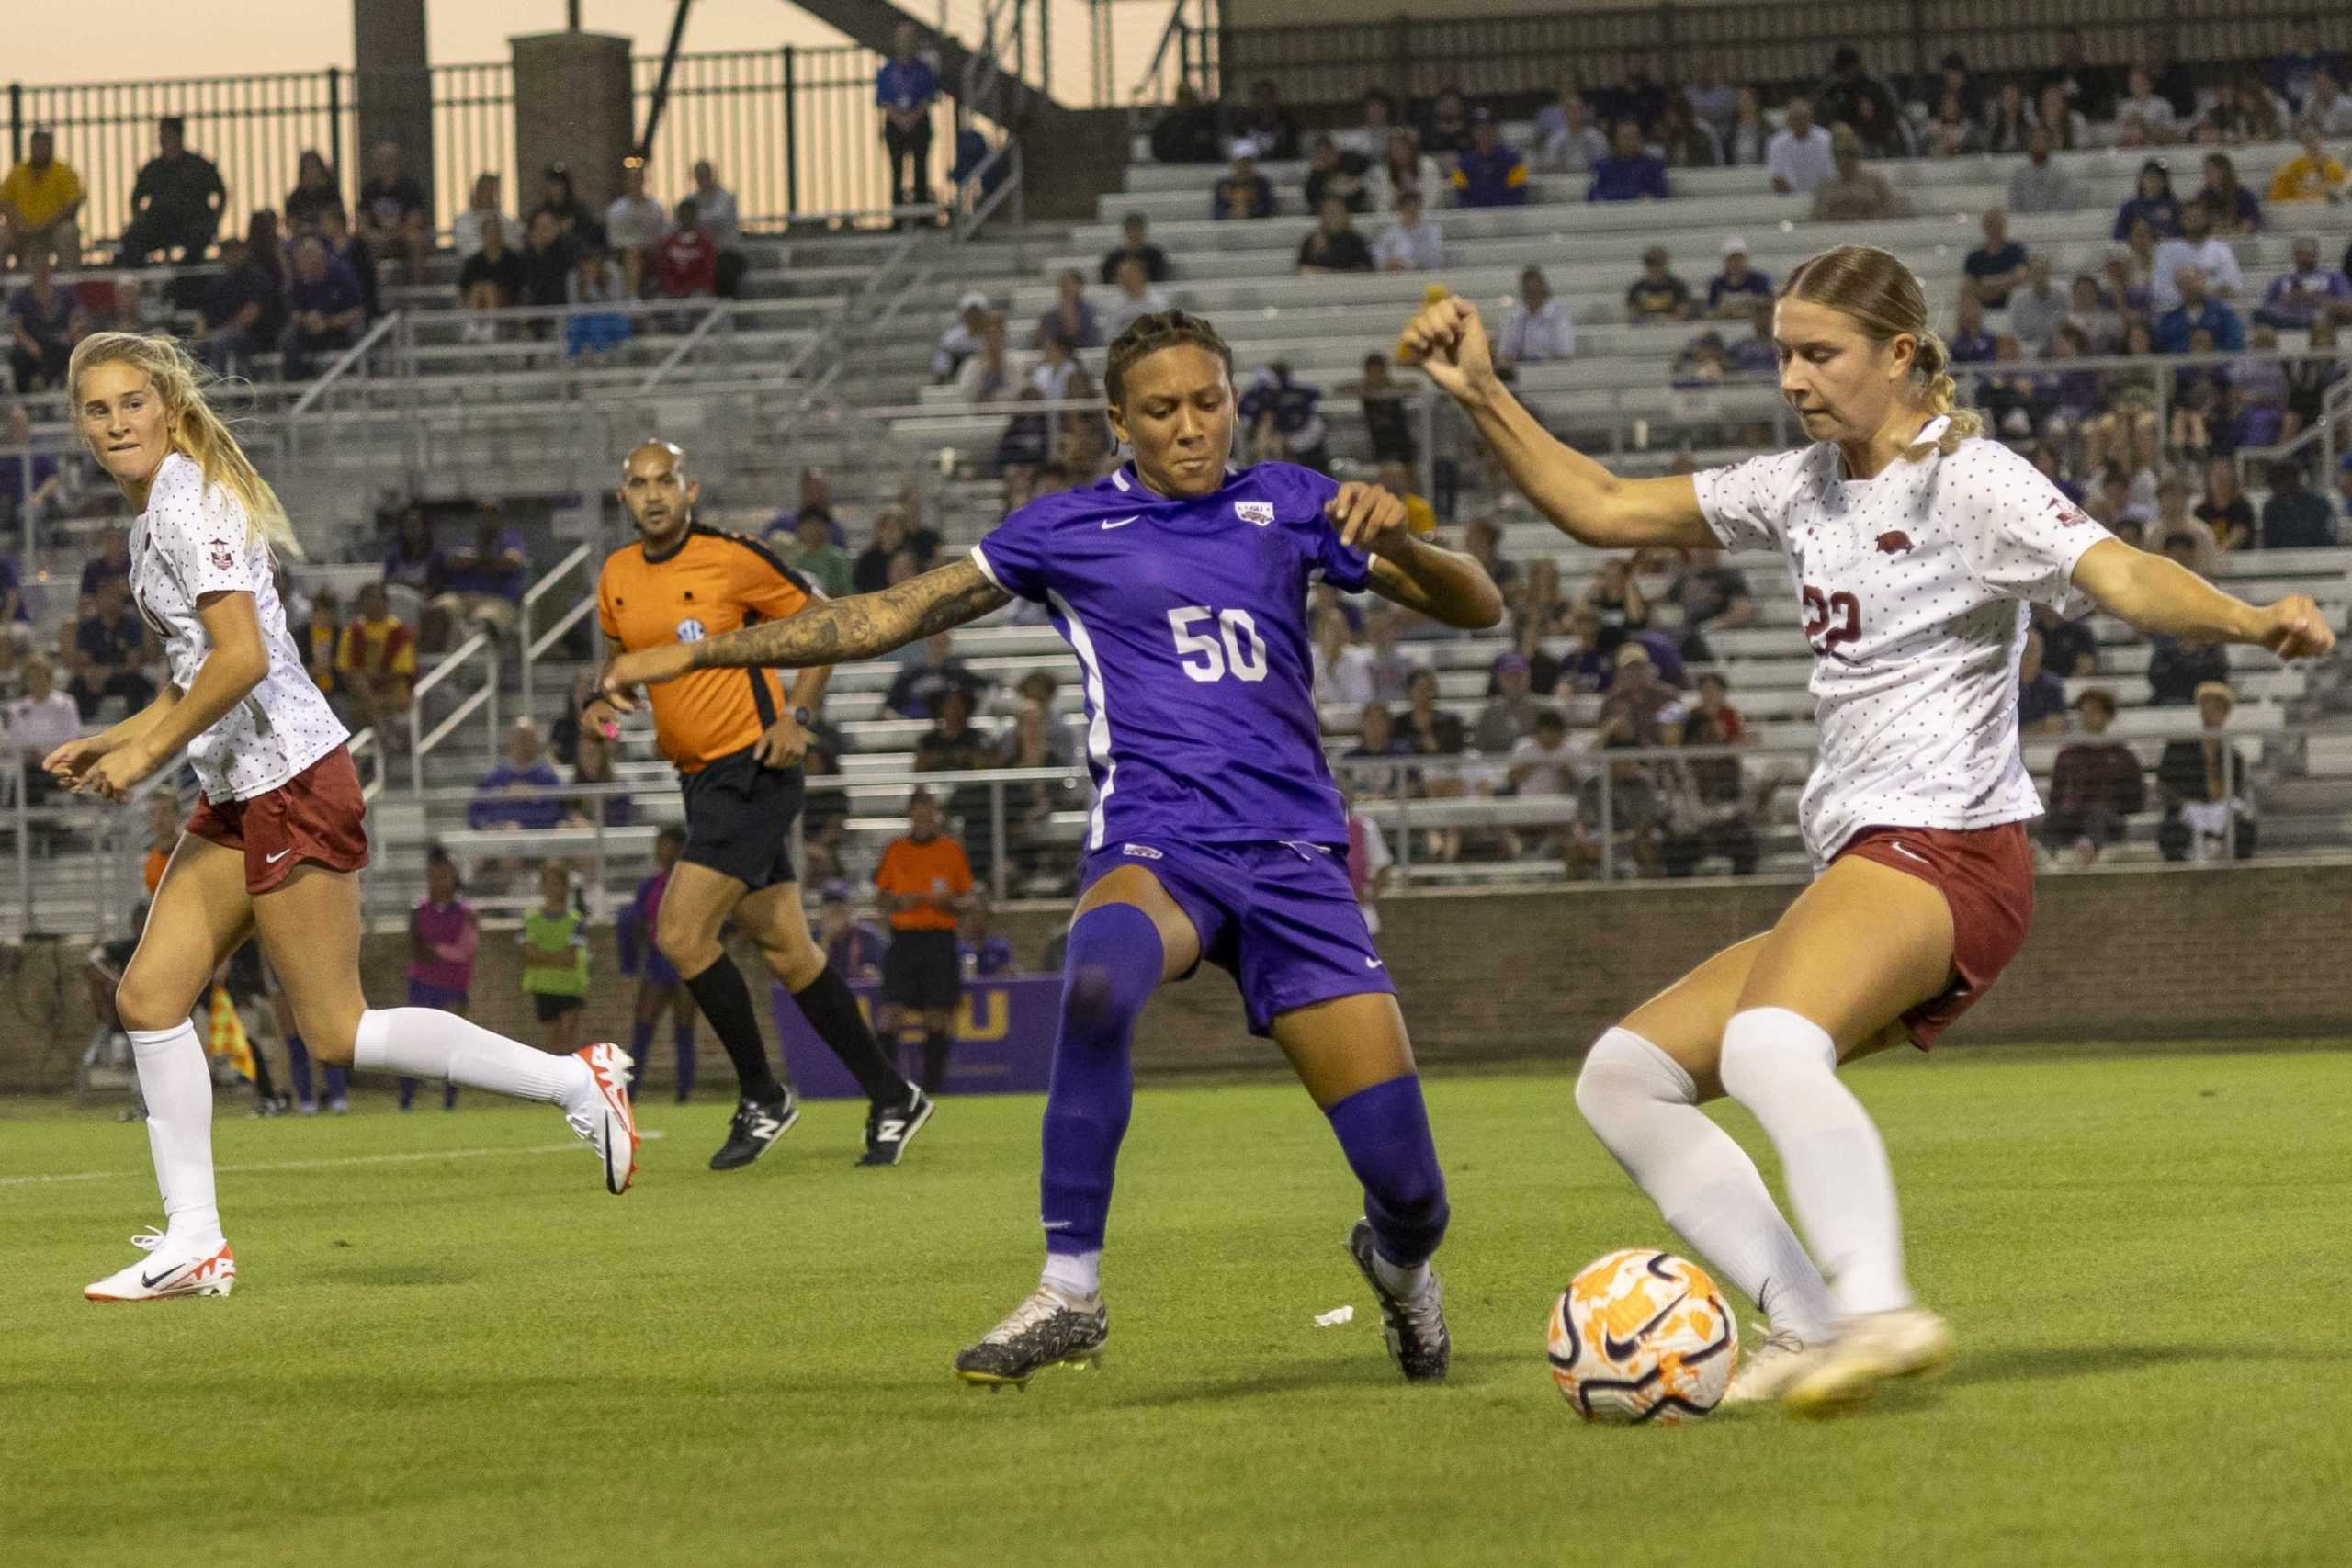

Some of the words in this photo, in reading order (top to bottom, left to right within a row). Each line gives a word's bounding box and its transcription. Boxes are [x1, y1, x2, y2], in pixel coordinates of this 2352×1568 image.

[1167, 606, 1269, 682] 50
[1804, 585, 1861, 656] 22
[877, 1120, 907, 1141] N
